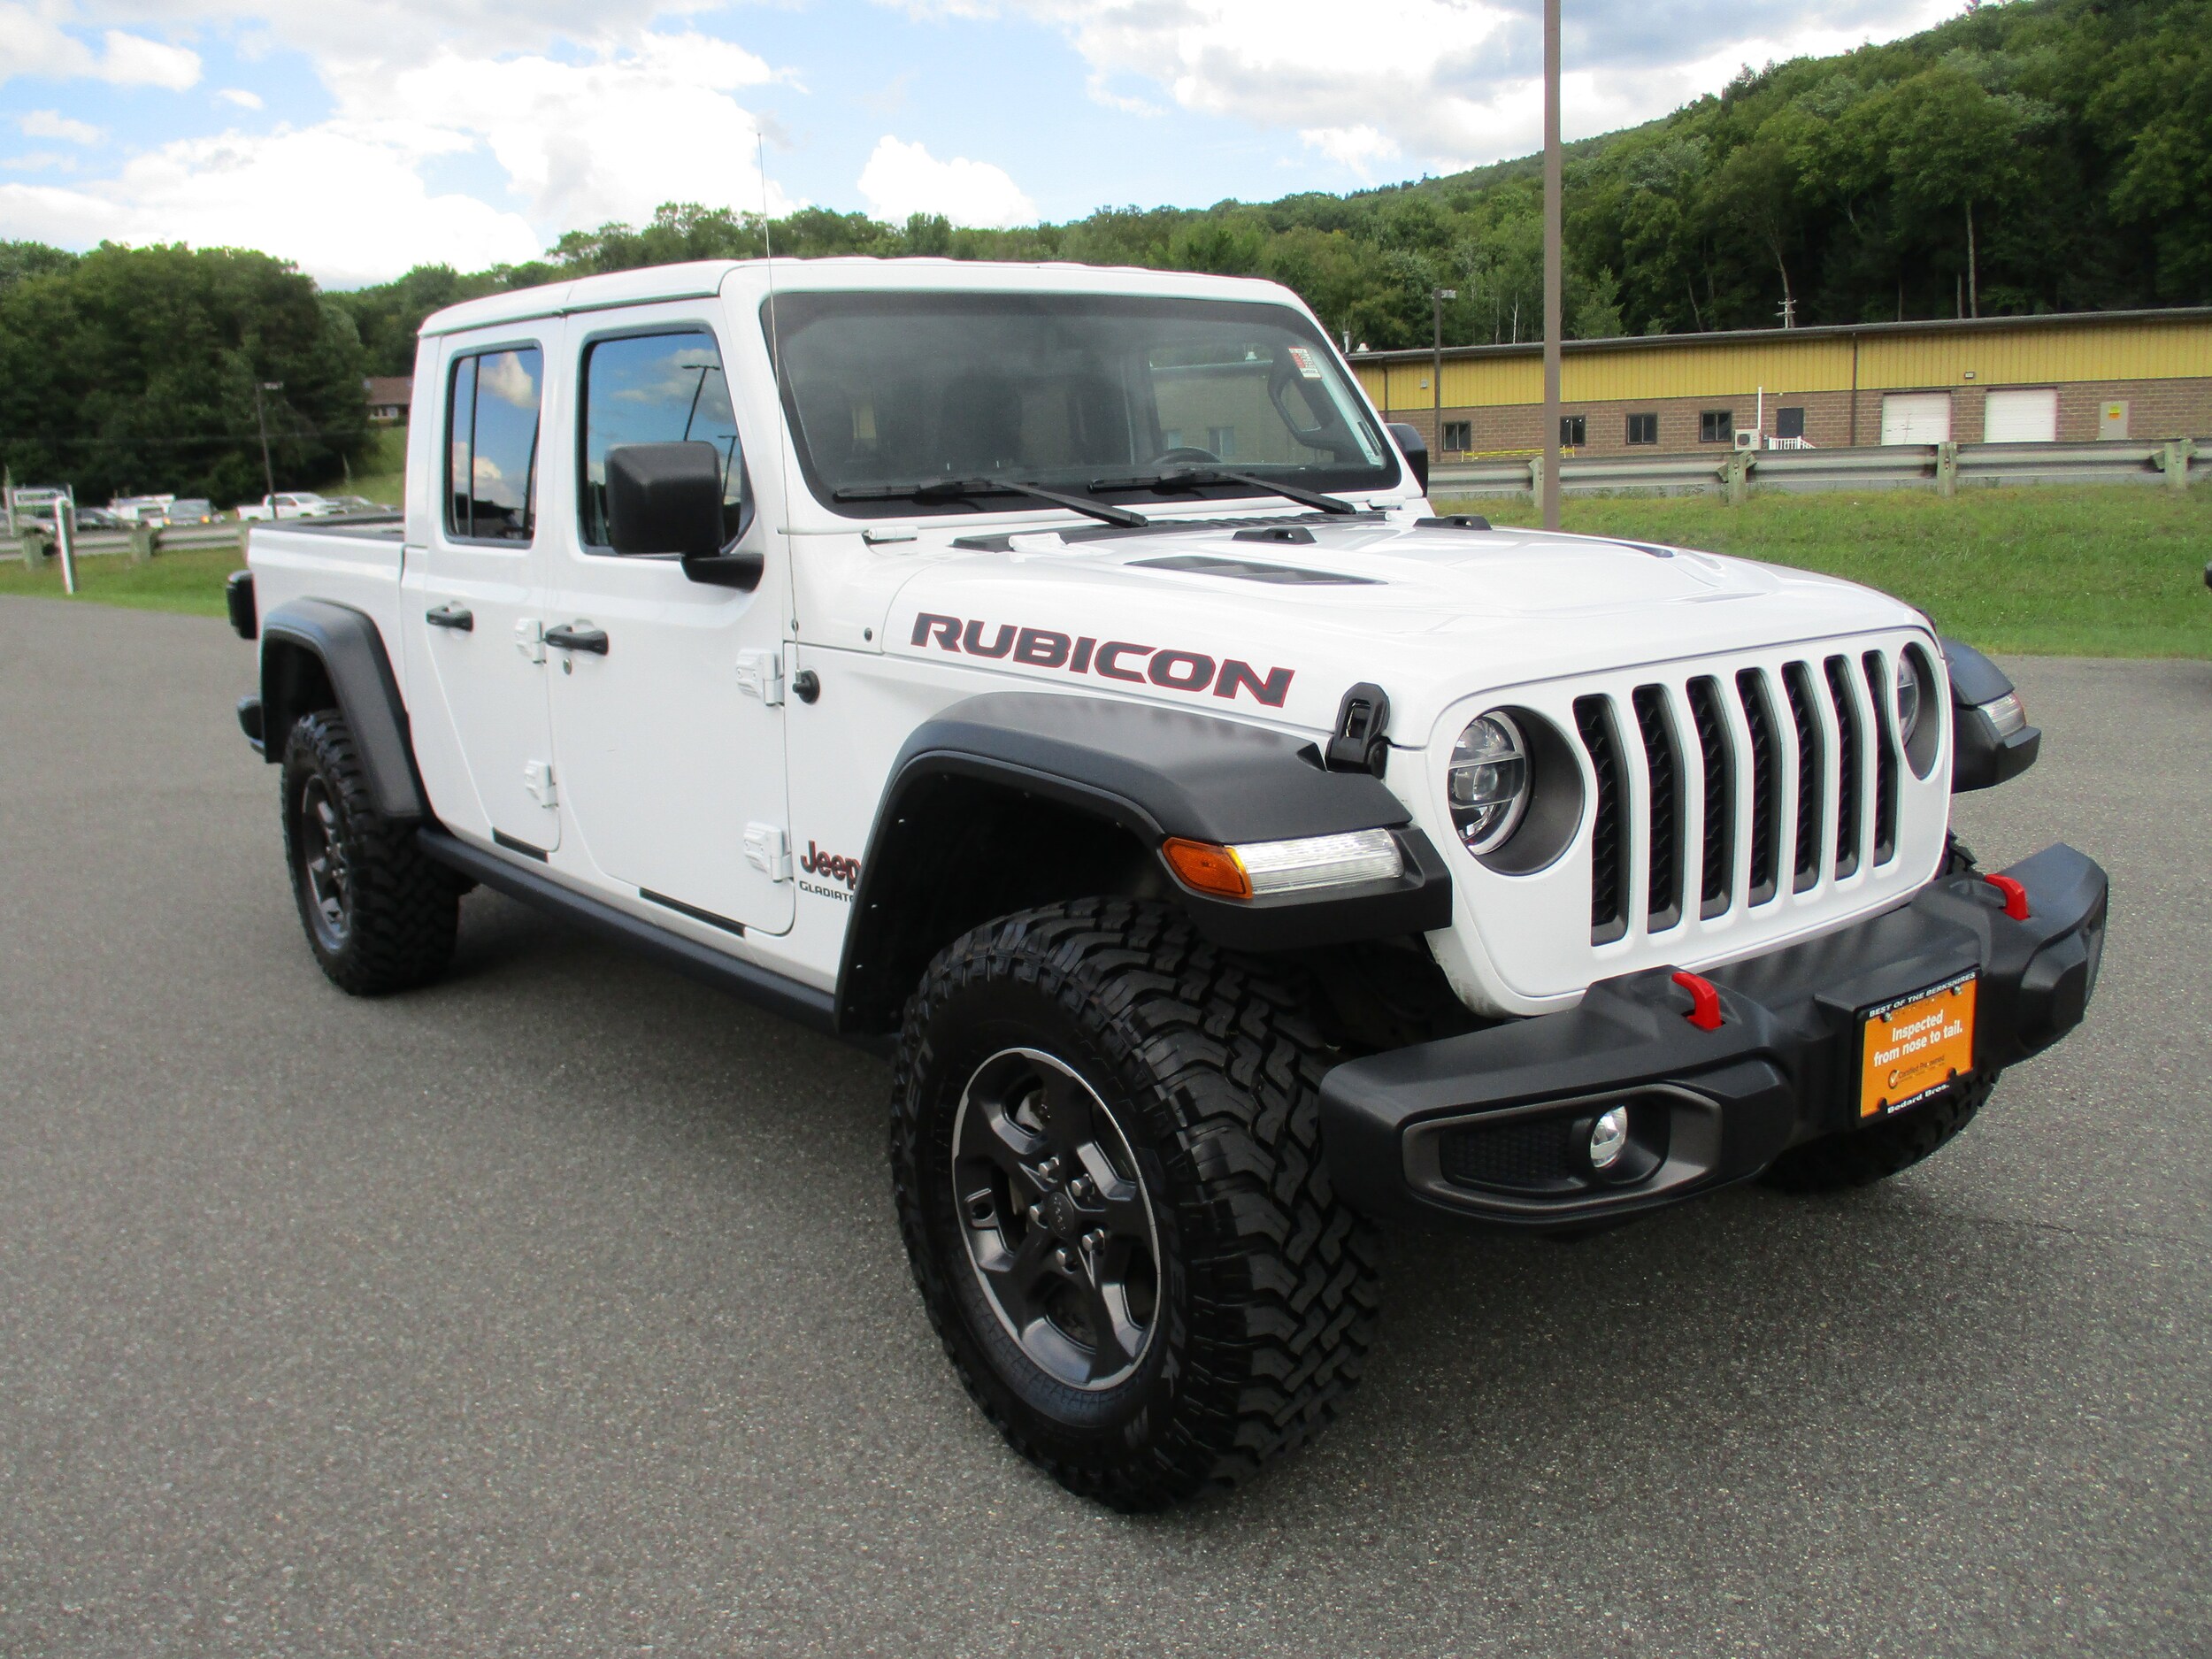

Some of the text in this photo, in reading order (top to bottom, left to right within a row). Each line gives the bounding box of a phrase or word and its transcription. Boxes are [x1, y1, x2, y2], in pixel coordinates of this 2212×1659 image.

[910, 612, 1296, 709] RUBICON
[799, 840, 862, 891] Jeep
[1869, 972, 1976, 1018] BEST OF THE BERKSHIRES
[1873, 1019, 1963, 1067] from nose to tail.
[1892, 1009, 1944, 1042] Inspected
[1887, 1084, 1950, 1114] Bedard Bros.
